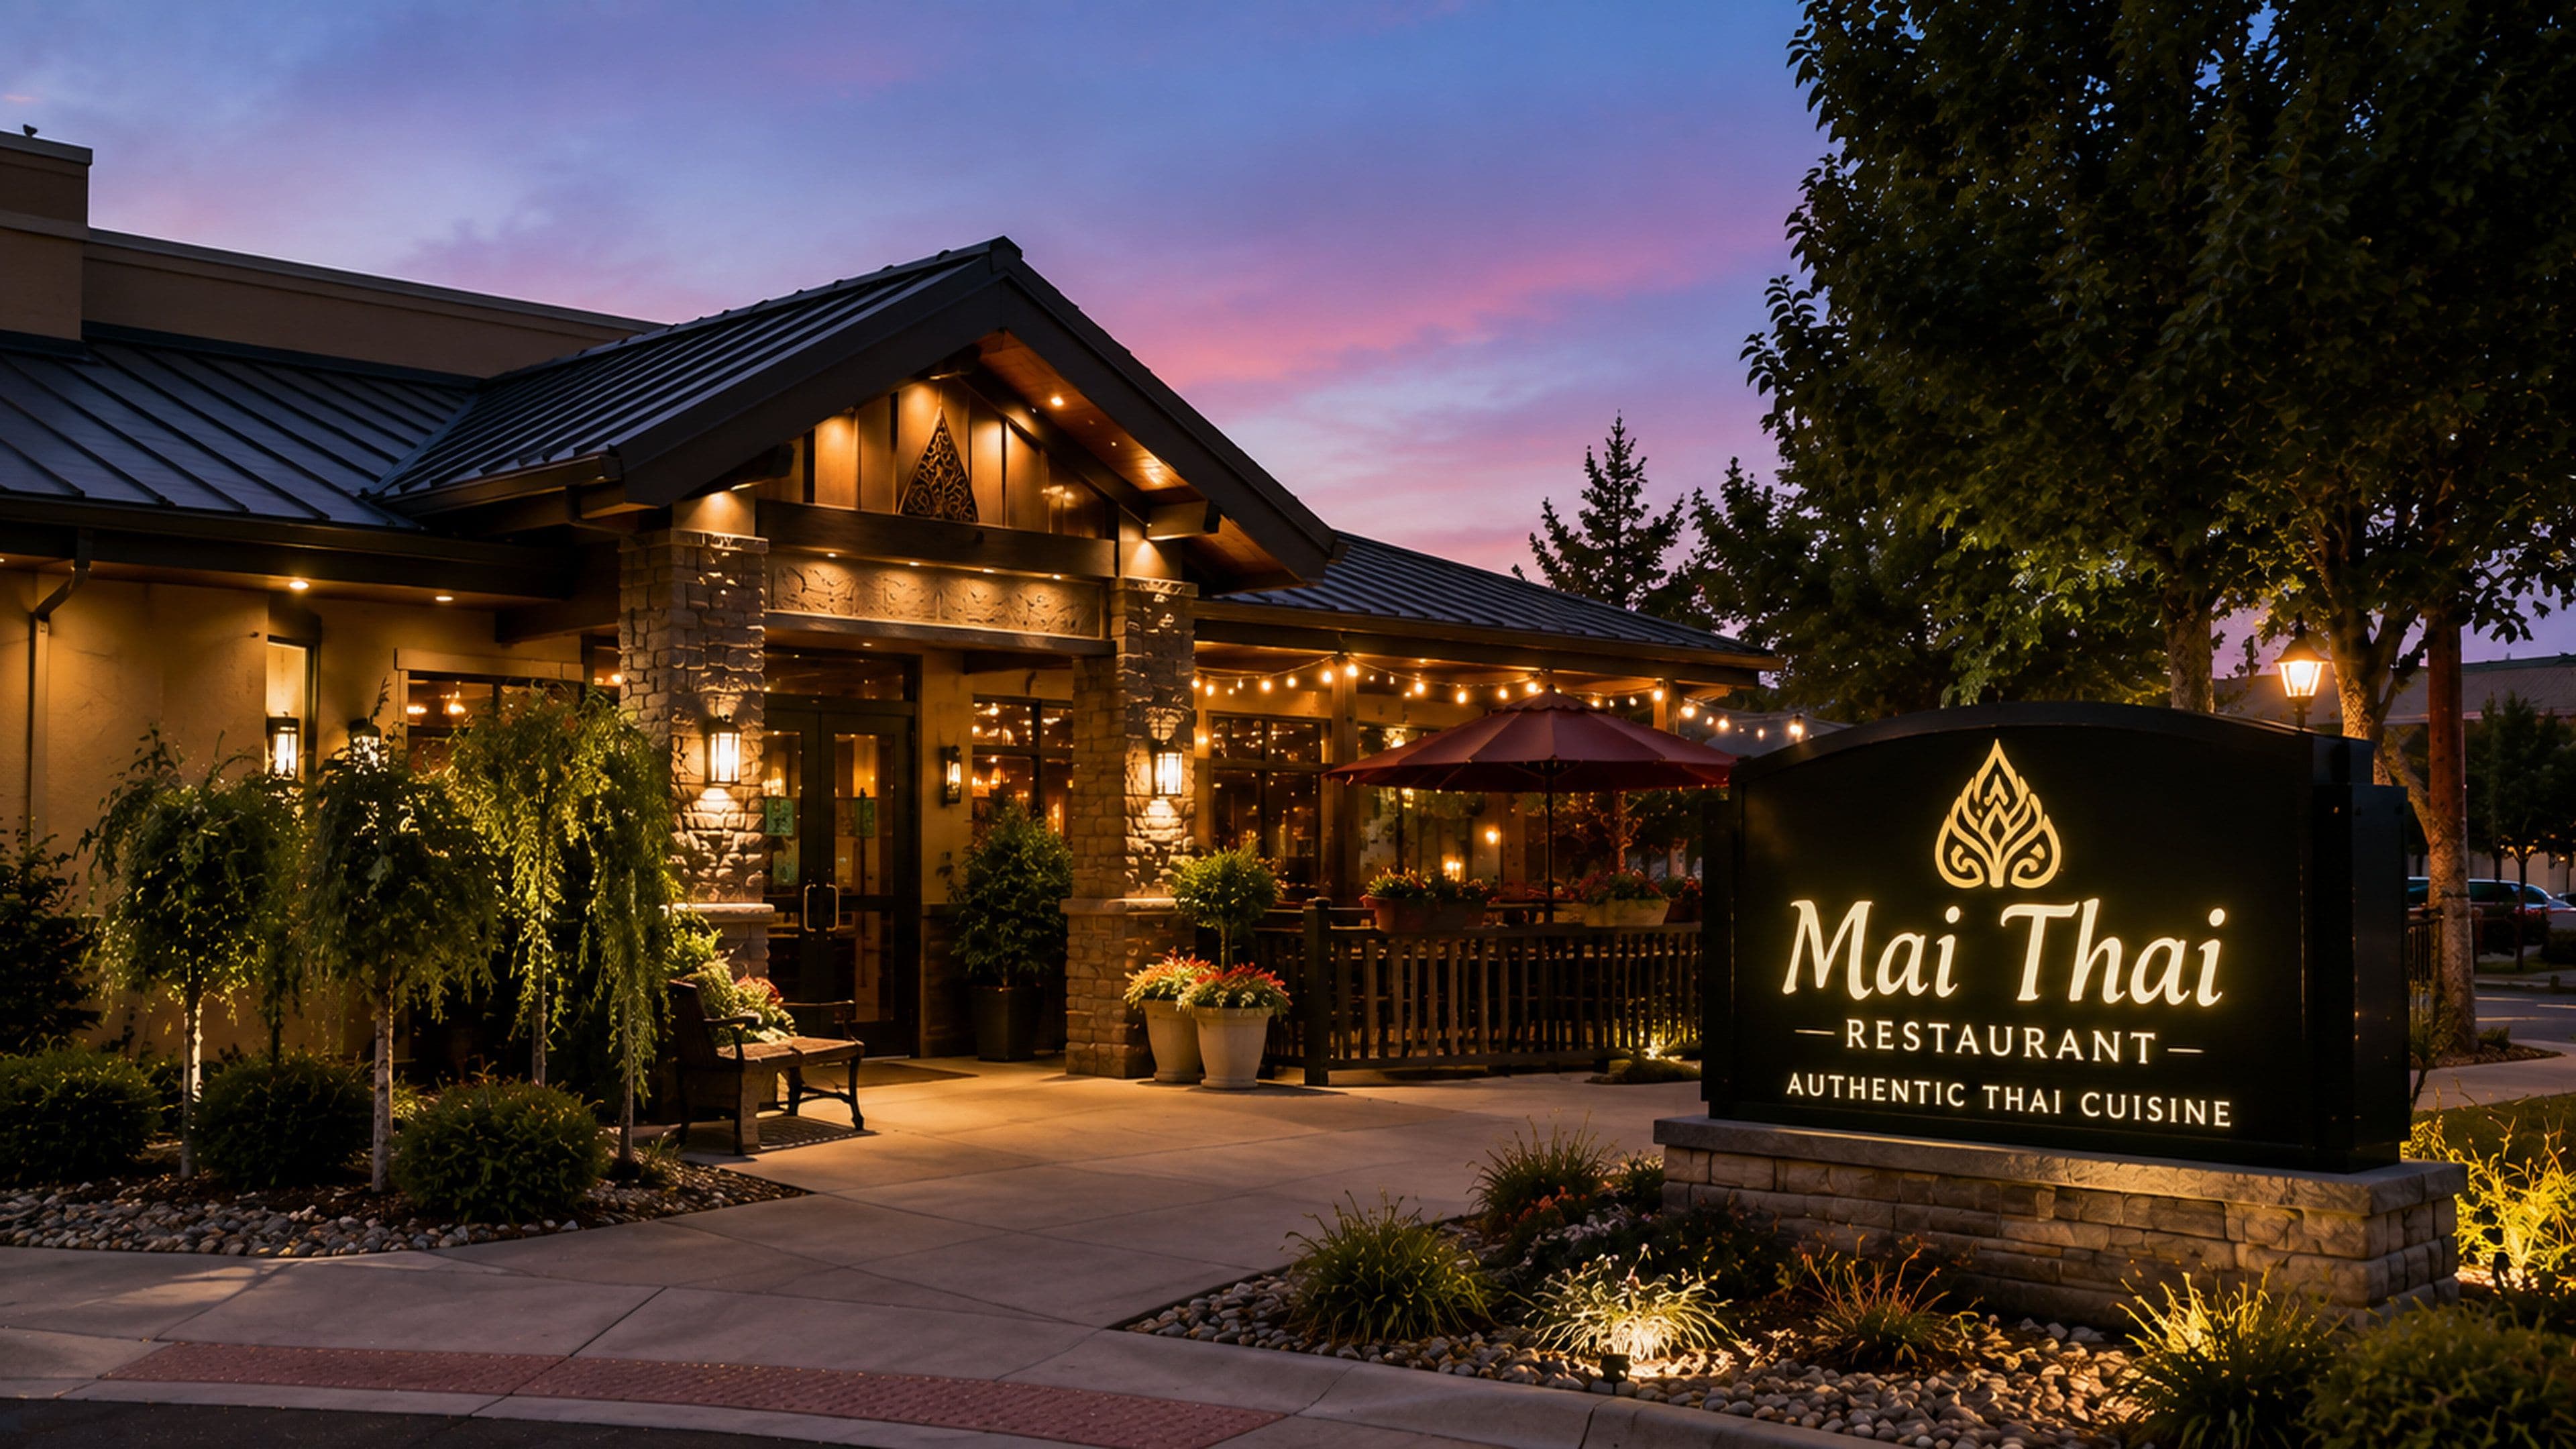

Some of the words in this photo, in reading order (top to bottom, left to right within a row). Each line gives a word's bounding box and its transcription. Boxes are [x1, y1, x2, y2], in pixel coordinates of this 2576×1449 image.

[1782, 900, 1961, 1002] Mai
[2000, 898, 2226, 1007] Thai
[1846, 1018, 2156, 1065] RESTAURANT
[1786, 1073, 1966, 1108] AUTHENTIC
[1982, 1085, 2061, 1115] THAI
[2081, 1091, 2231, 1128] CUISINE
